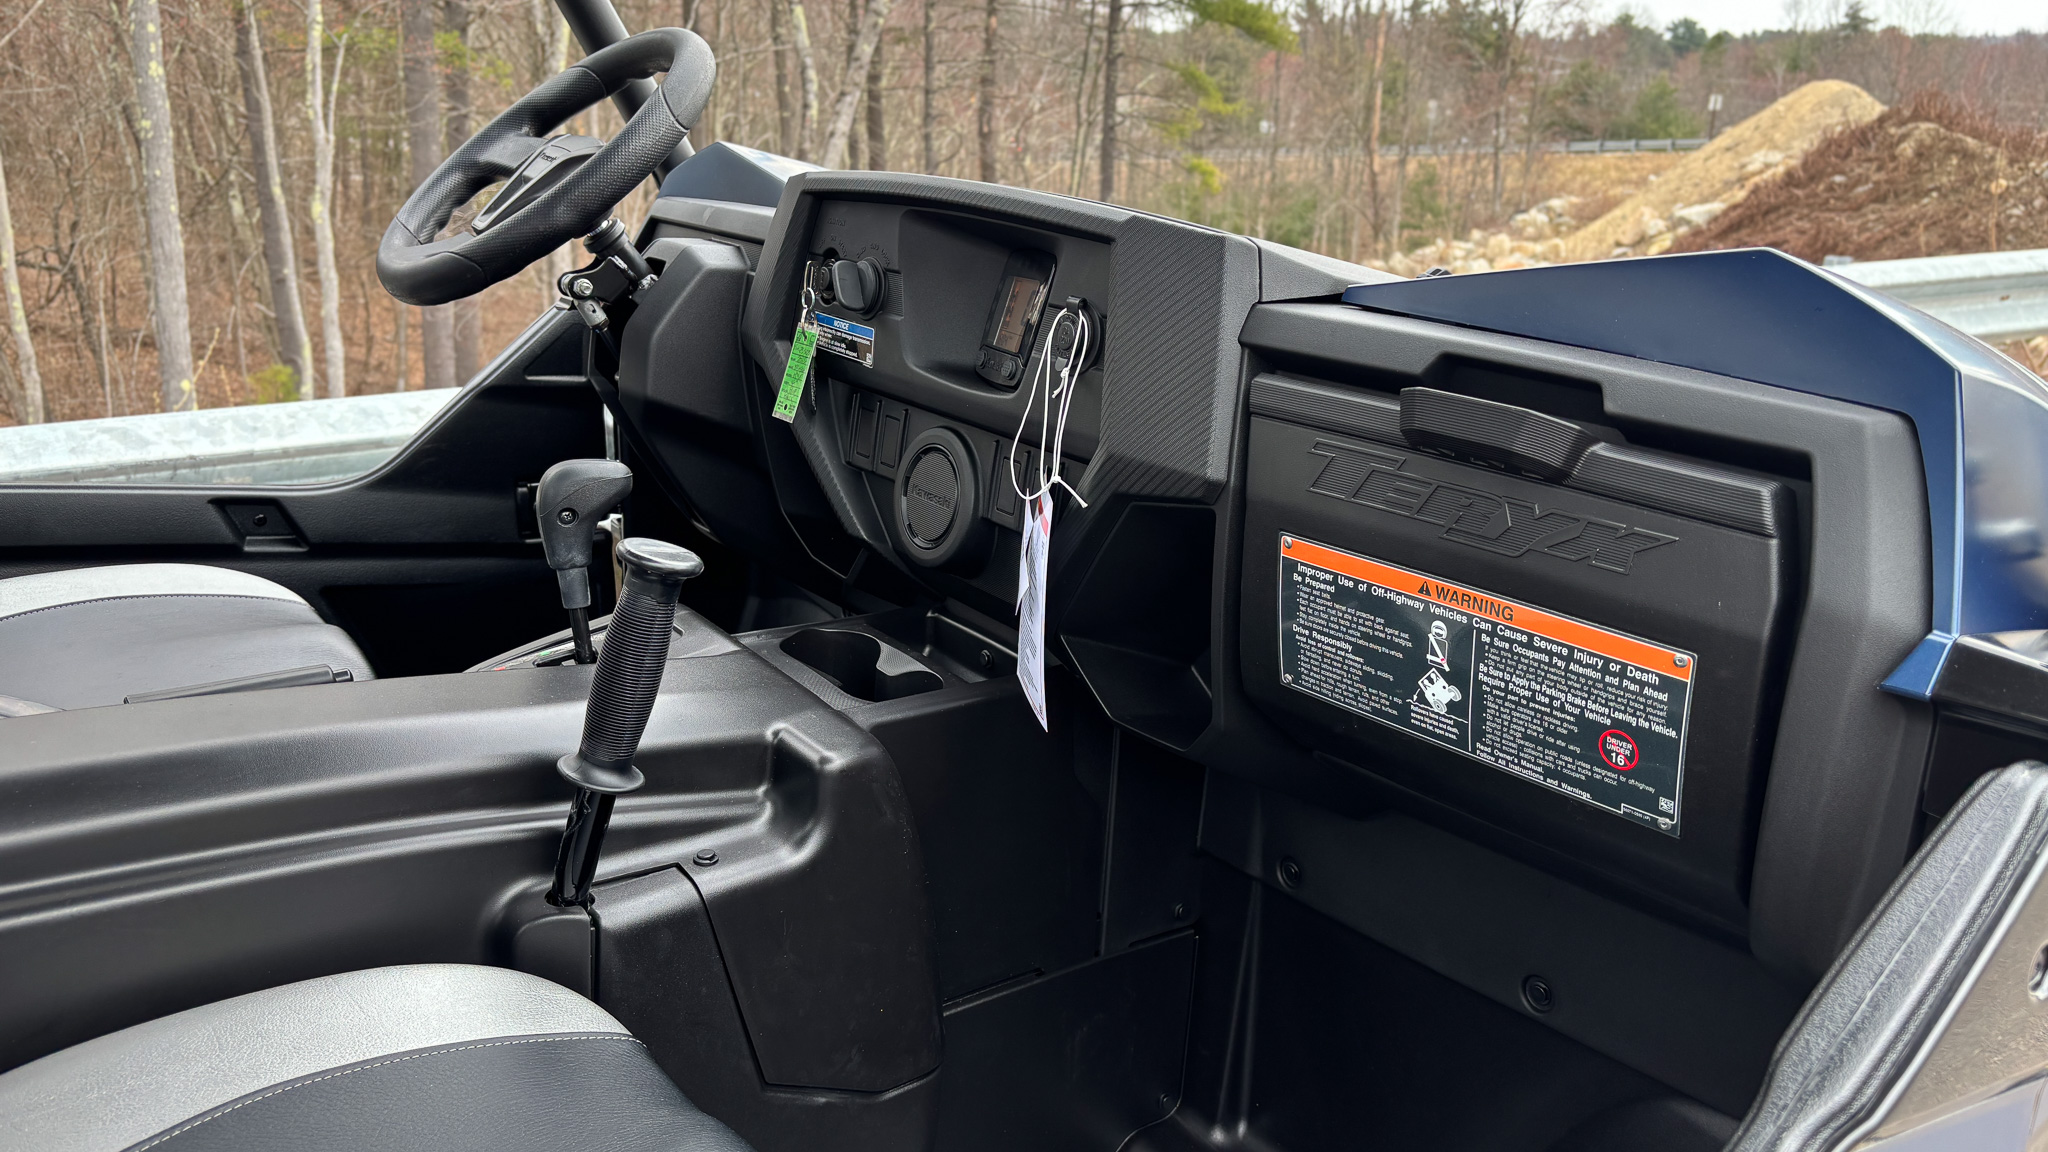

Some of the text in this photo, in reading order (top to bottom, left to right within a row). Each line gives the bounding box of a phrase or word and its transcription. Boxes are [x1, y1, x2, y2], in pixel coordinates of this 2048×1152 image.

[833, 320, 850, 331] NOTICE
[911, 483, 952, 510] Kawasaki
[1293, 572, 1335, 593] Be Prepared
[1436, 585, 1514, 622] WARNING
[1292, 623, 1352, 652] Drive Responsibly
[1297, 562, 1659, 685] Improper Use of Off-Highway Vehicles Can Cause Severe Injury or Death
[1481, 633, 1668, 702] Be Sure Occupants Pay Attention and Plan Ahead
[1478, 672, 1611, 726] Require Proper Use of Your Vehicle
[1479, 662, 1678, 739] Be Sure to Apply the Parking Brake Before Leaving the Vehicle.
[1482, 684, 1490, 692] Do
[1507, 694, 1519, 702] part
[1529, 701, 1550, 713] prevent
[1552, 709, 1576, 722] injuries:
[1476, 742, 1491, 753] Read
[1493, 749, 1518, 763] Owner's
[1606, 736, 1633, 751] DRIVER
[1606, 742, 1631, 757] UNDER
[1610, 752, 1625, 766] 16
[1476, 749, 1592, 799] Follow All Instructions and Warnings.
